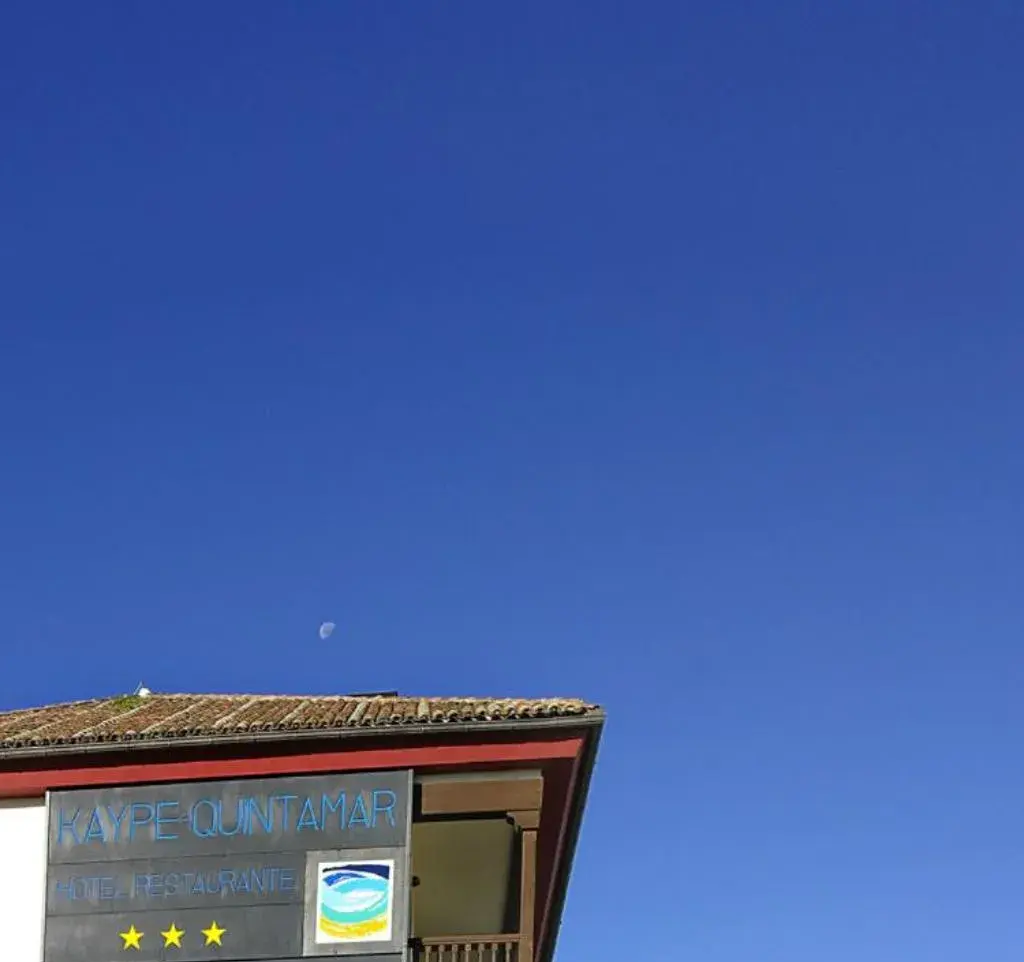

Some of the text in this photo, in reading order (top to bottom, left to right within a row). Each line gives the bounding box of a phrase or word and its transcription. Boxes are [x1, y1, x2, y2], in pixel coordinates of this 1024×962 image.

[57, 789, 397, 845] KAYPE QUINTAMAR
[56, 866, 298, 902] HOTEL RESTAURANTE
